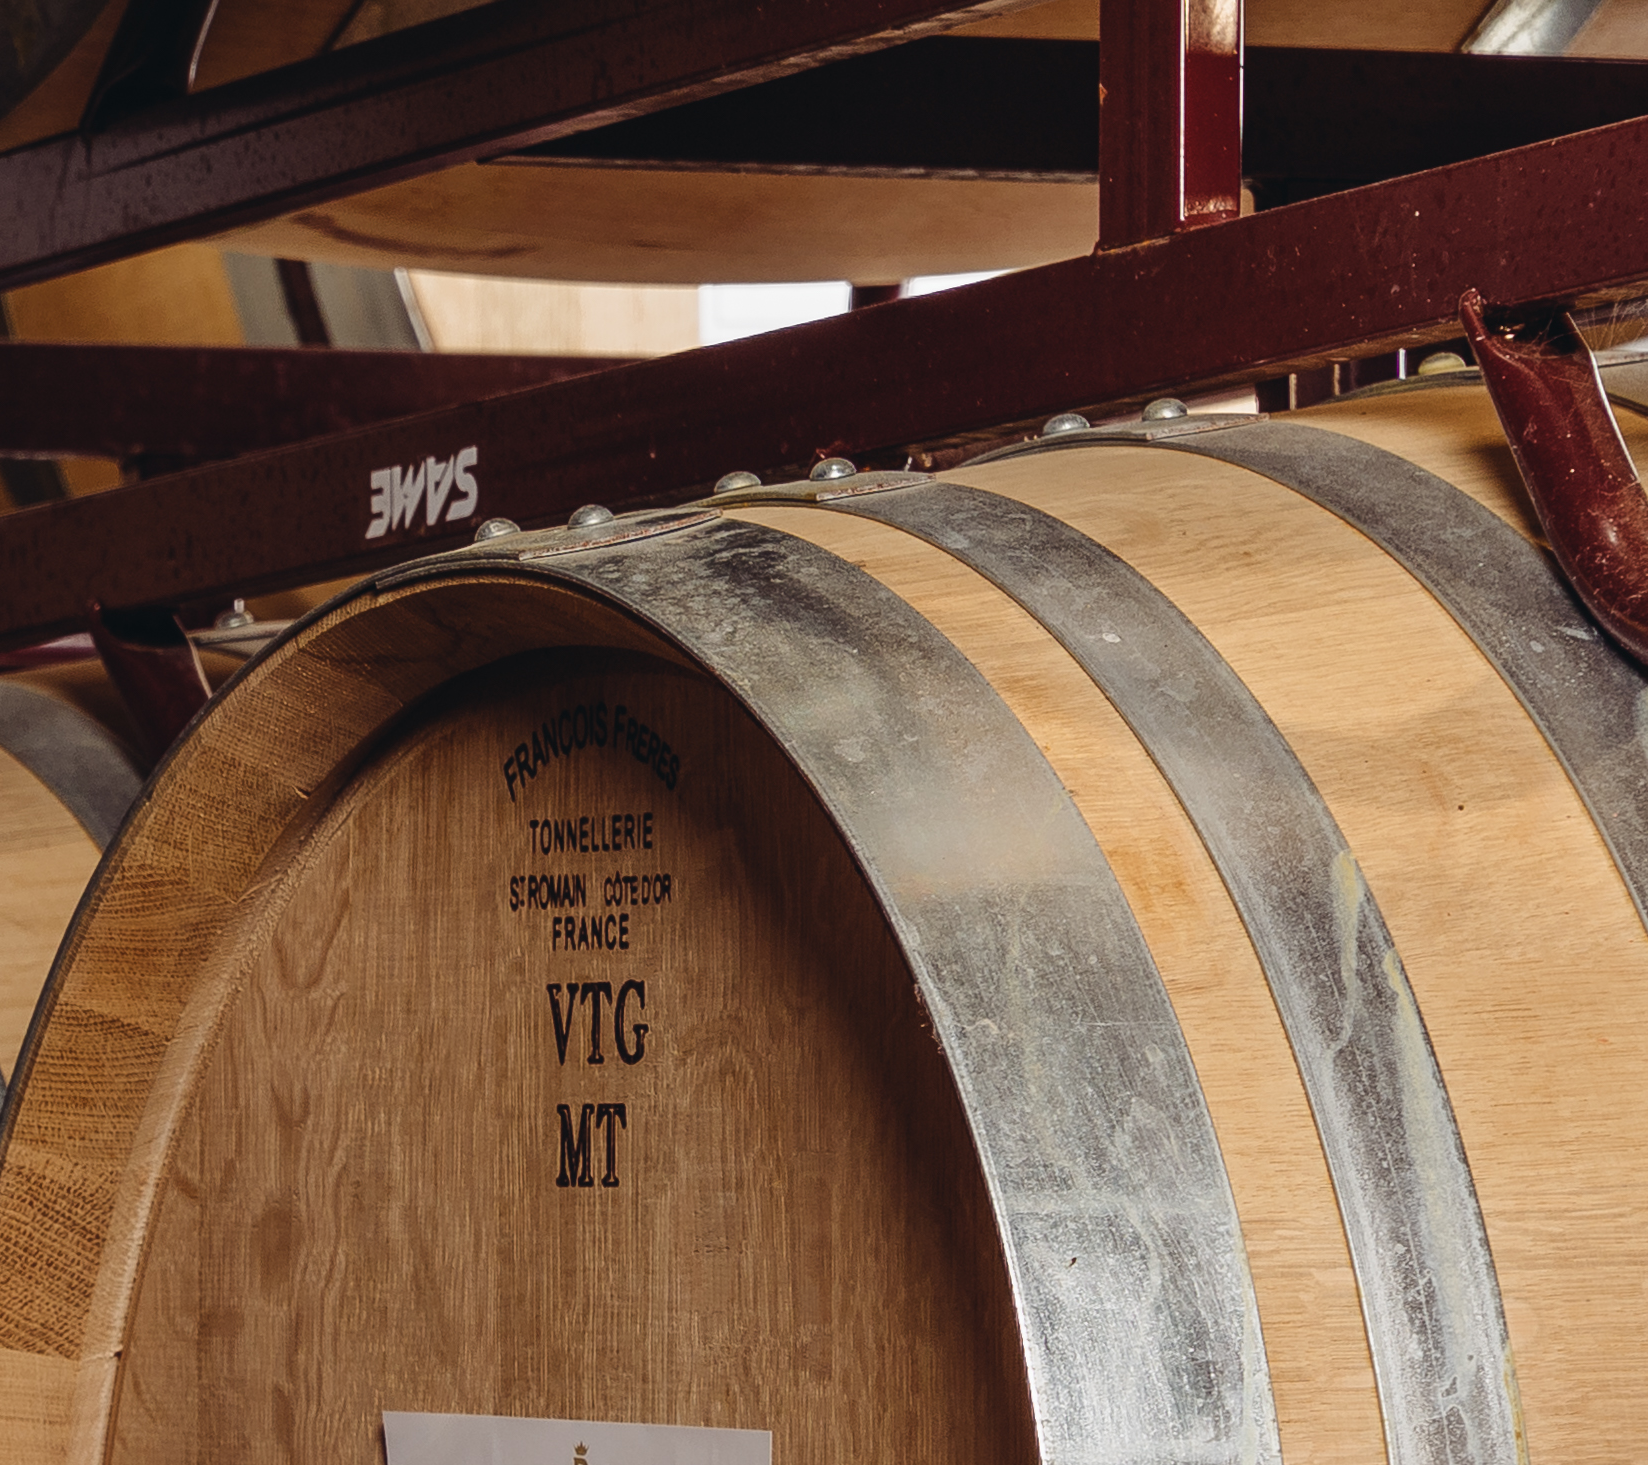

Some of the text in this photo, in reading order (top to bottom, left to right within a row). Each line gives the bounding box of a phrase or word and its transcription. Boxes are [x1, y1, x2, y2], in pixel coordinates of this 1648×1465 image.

[365, 445, 478, 539] SAME
[529, 812, 653, 856] TONNELLERIE
[528, 874, 587, 910] ROMAIN
[553, 913, 629, 952] FRANCE
[547, 979, 650, 1066] VTG
[556, 1102, 628, 1188] MT
